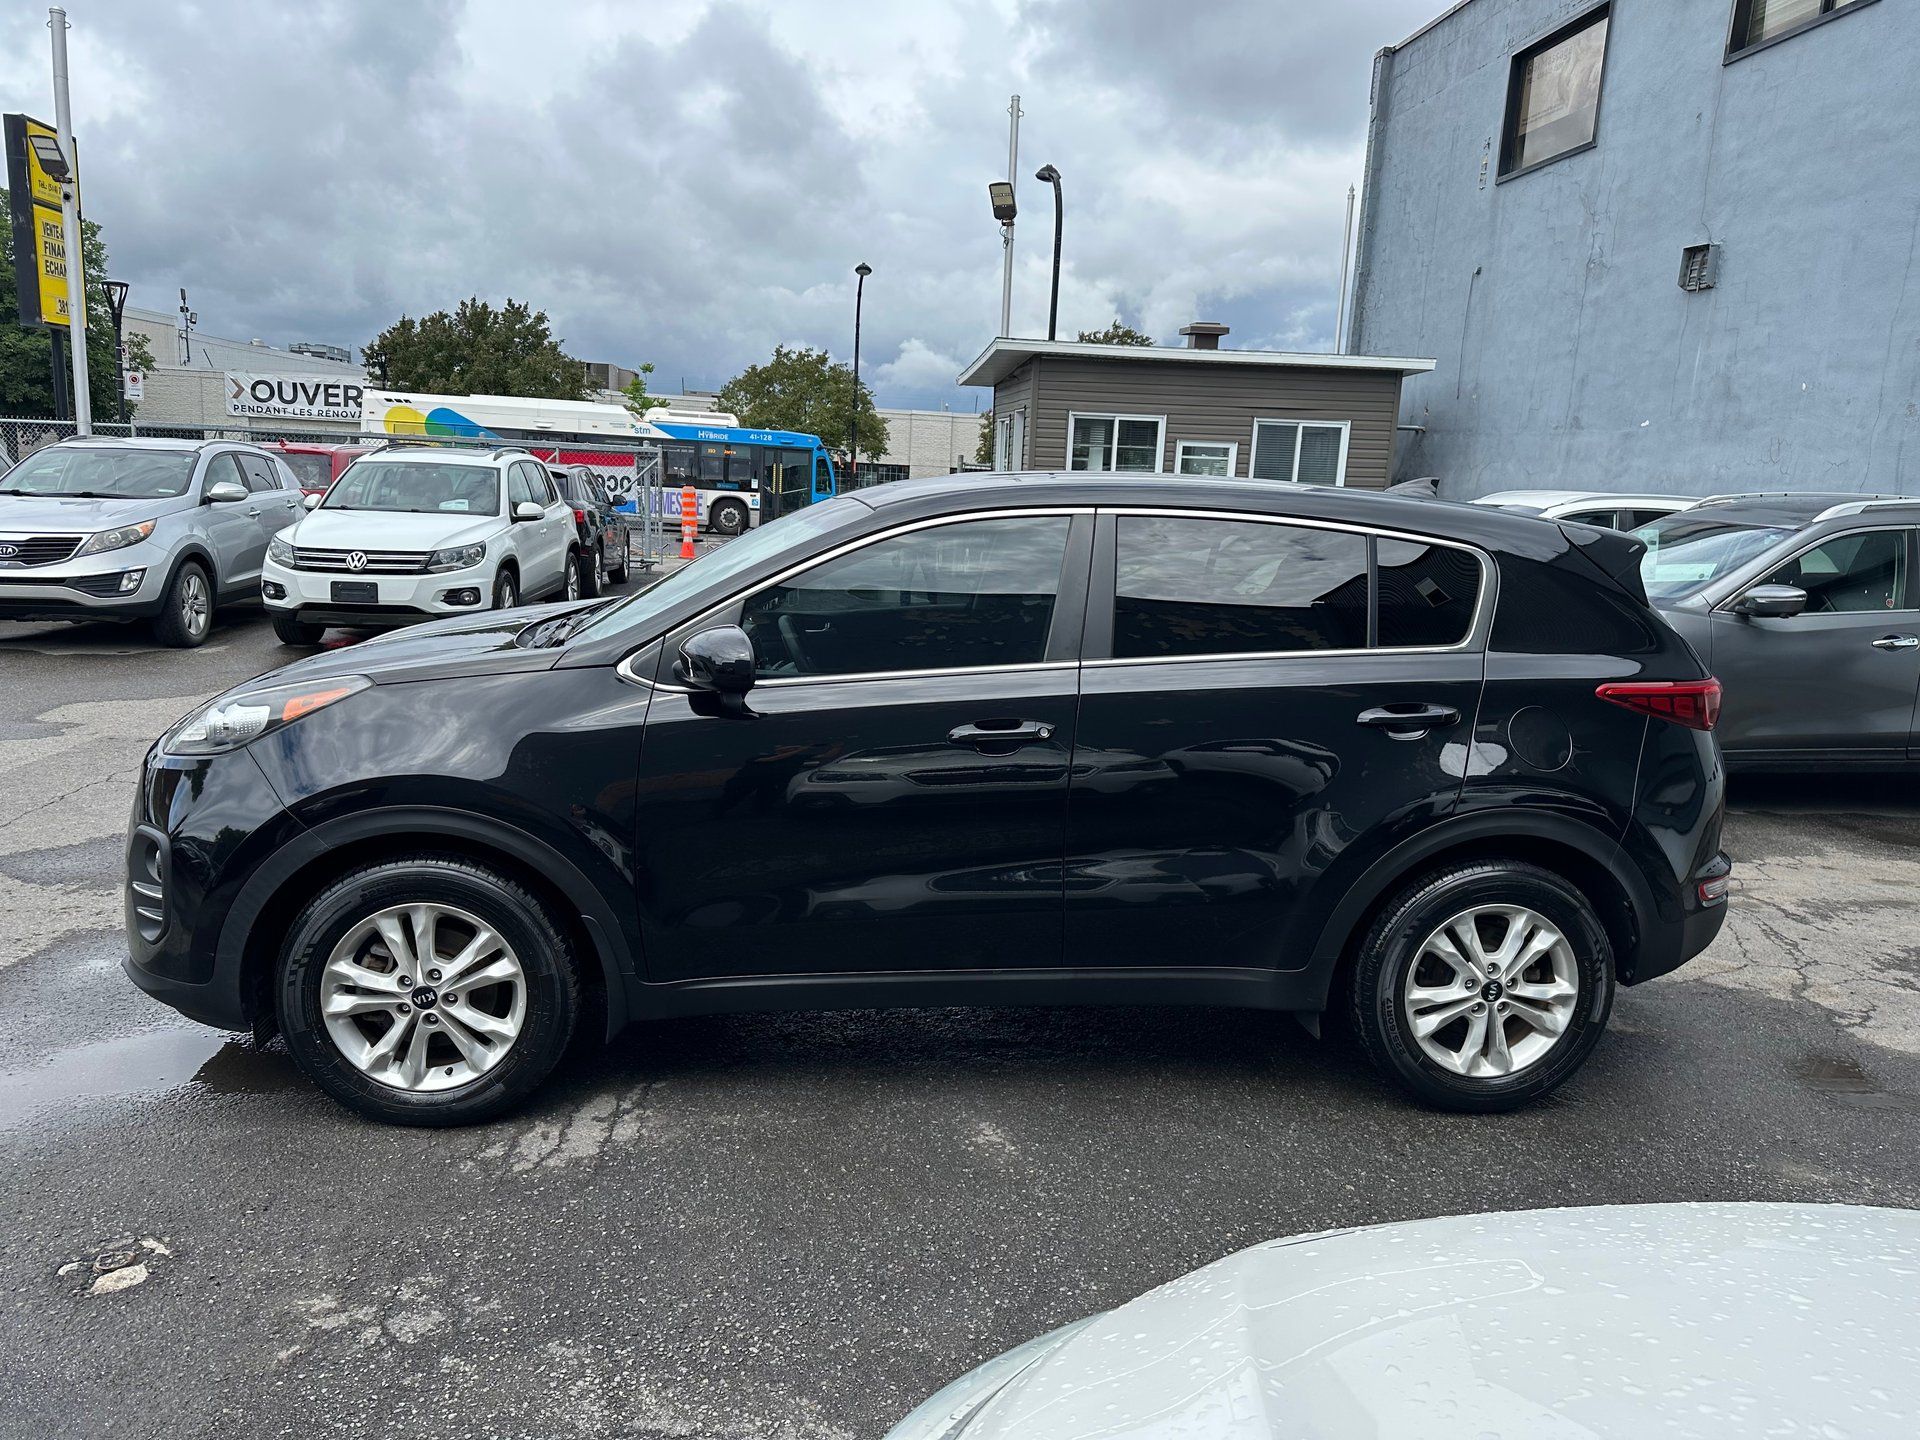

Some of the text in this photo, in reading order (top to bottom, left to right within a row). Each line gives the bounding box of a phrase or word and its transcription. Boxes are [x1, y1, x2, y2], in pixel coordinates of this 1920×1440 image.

[251, 379, 363, 408] OUVER
[234, 404, 287, 415] PENDANT
[293, 408, 312, 416] LES
[698, 430, 728, 440] HYBRIDE
[413, 991, 436, 1005] KIA
[1487, 983, 1498, 1001] KIA
